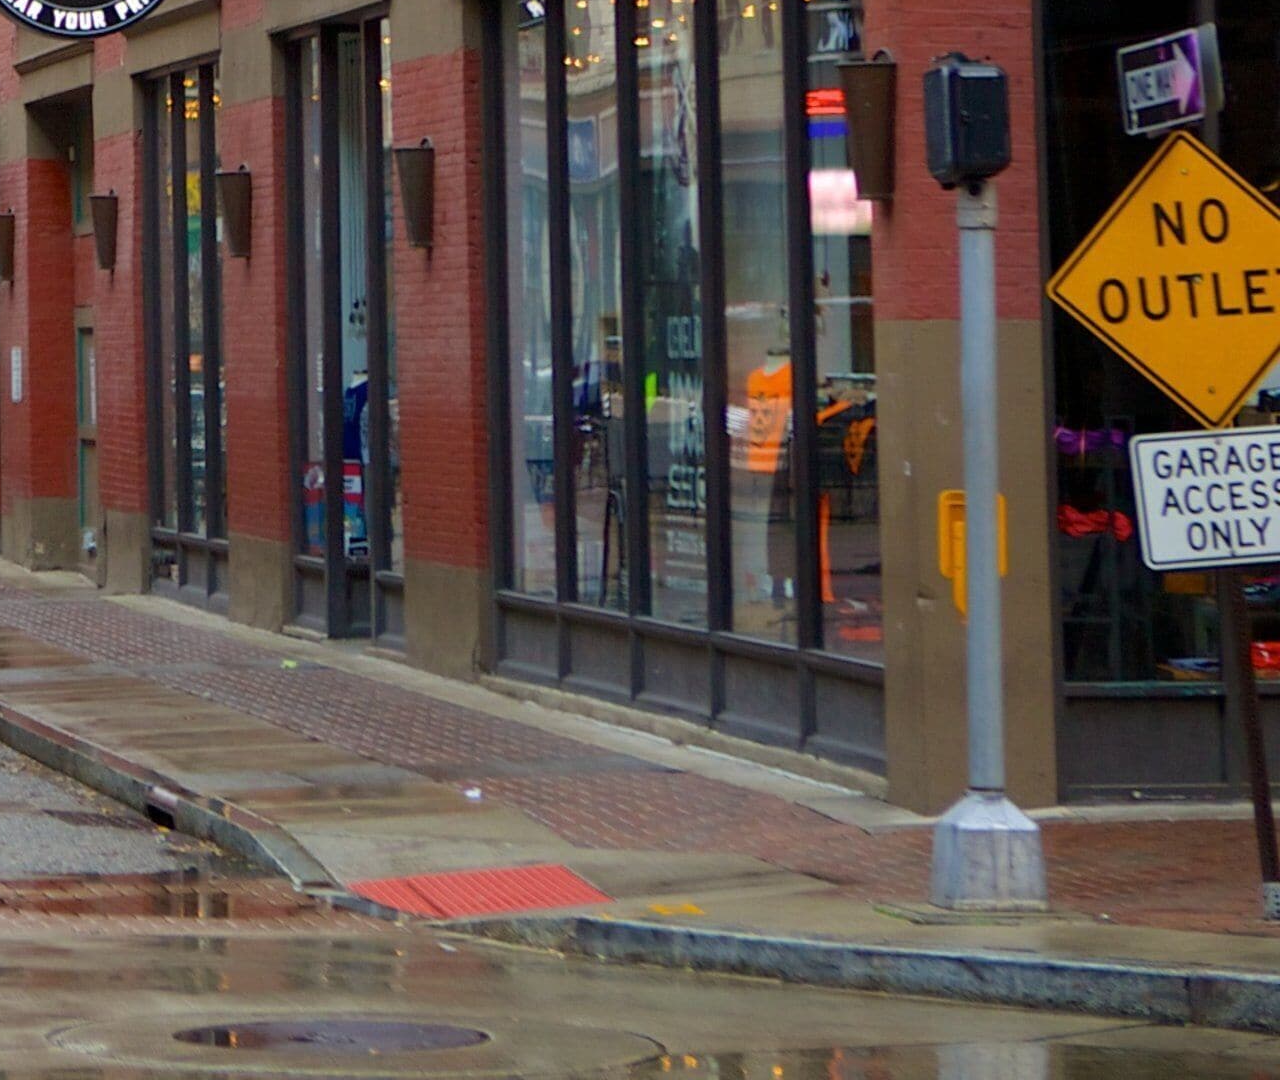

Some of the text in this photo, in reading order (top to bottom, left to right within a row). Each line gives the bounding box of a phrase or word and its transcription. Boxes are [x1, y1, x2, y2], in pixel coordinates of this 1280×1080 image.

[53, 8, 107, 31] YOUR
[1152, 197, 1230, 248] NO
[1097, 268, 1280, 324] OUTLE
[1186, 516, 1272, 552] ONLY
